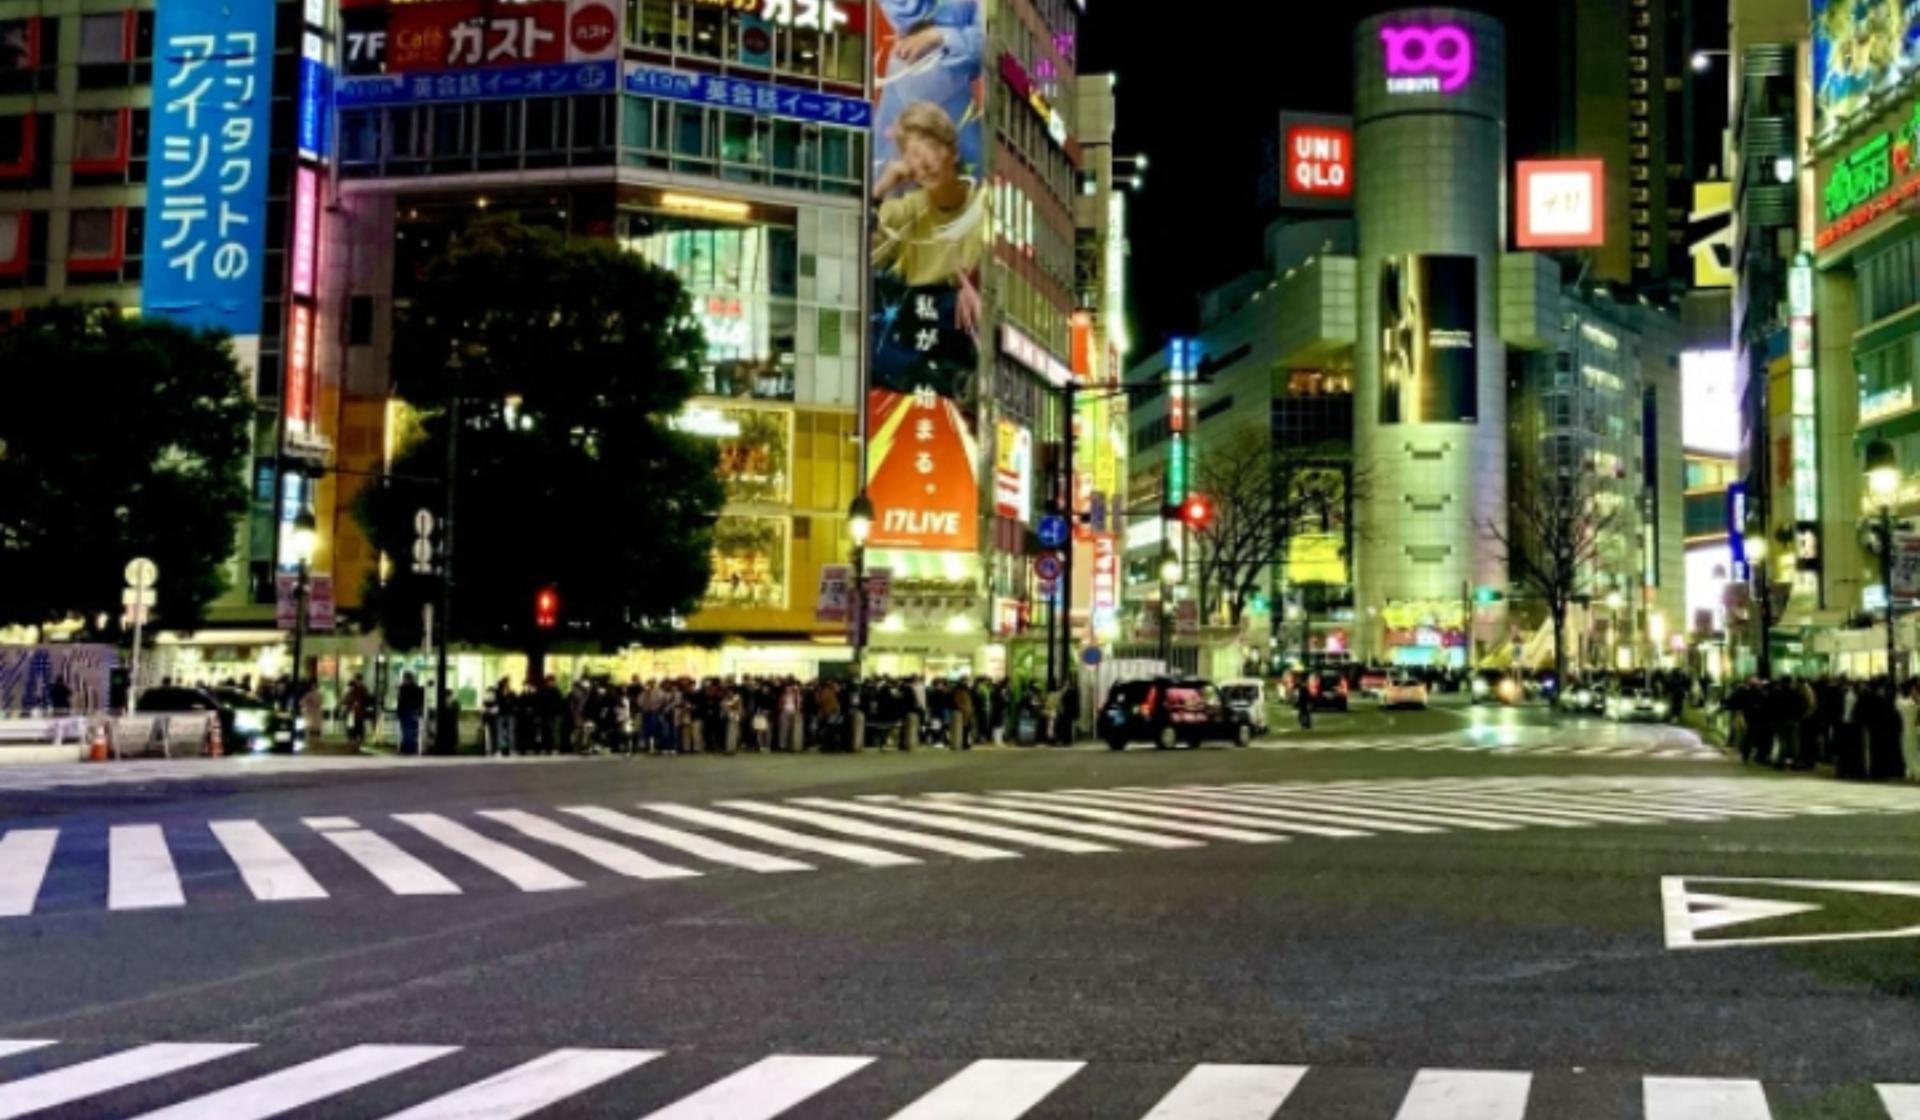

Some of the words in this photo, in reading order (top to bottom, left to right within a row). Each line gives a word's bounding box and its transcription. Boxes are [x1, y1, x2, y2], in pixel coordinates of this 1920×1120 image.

[346, 31, 386, 62] 7F
[448, 16, 554, 65] ガスト
[1379, 24, 1475, 93] 109
[161, 34, 216, 281] アイシティ
[212, 32, 257, 280] コンタクトの
[1295, 135, 1342, 161] UNI
[1295, 162, 1345, 189] QLO
[883, 508, 961, 536] 17LIVE
